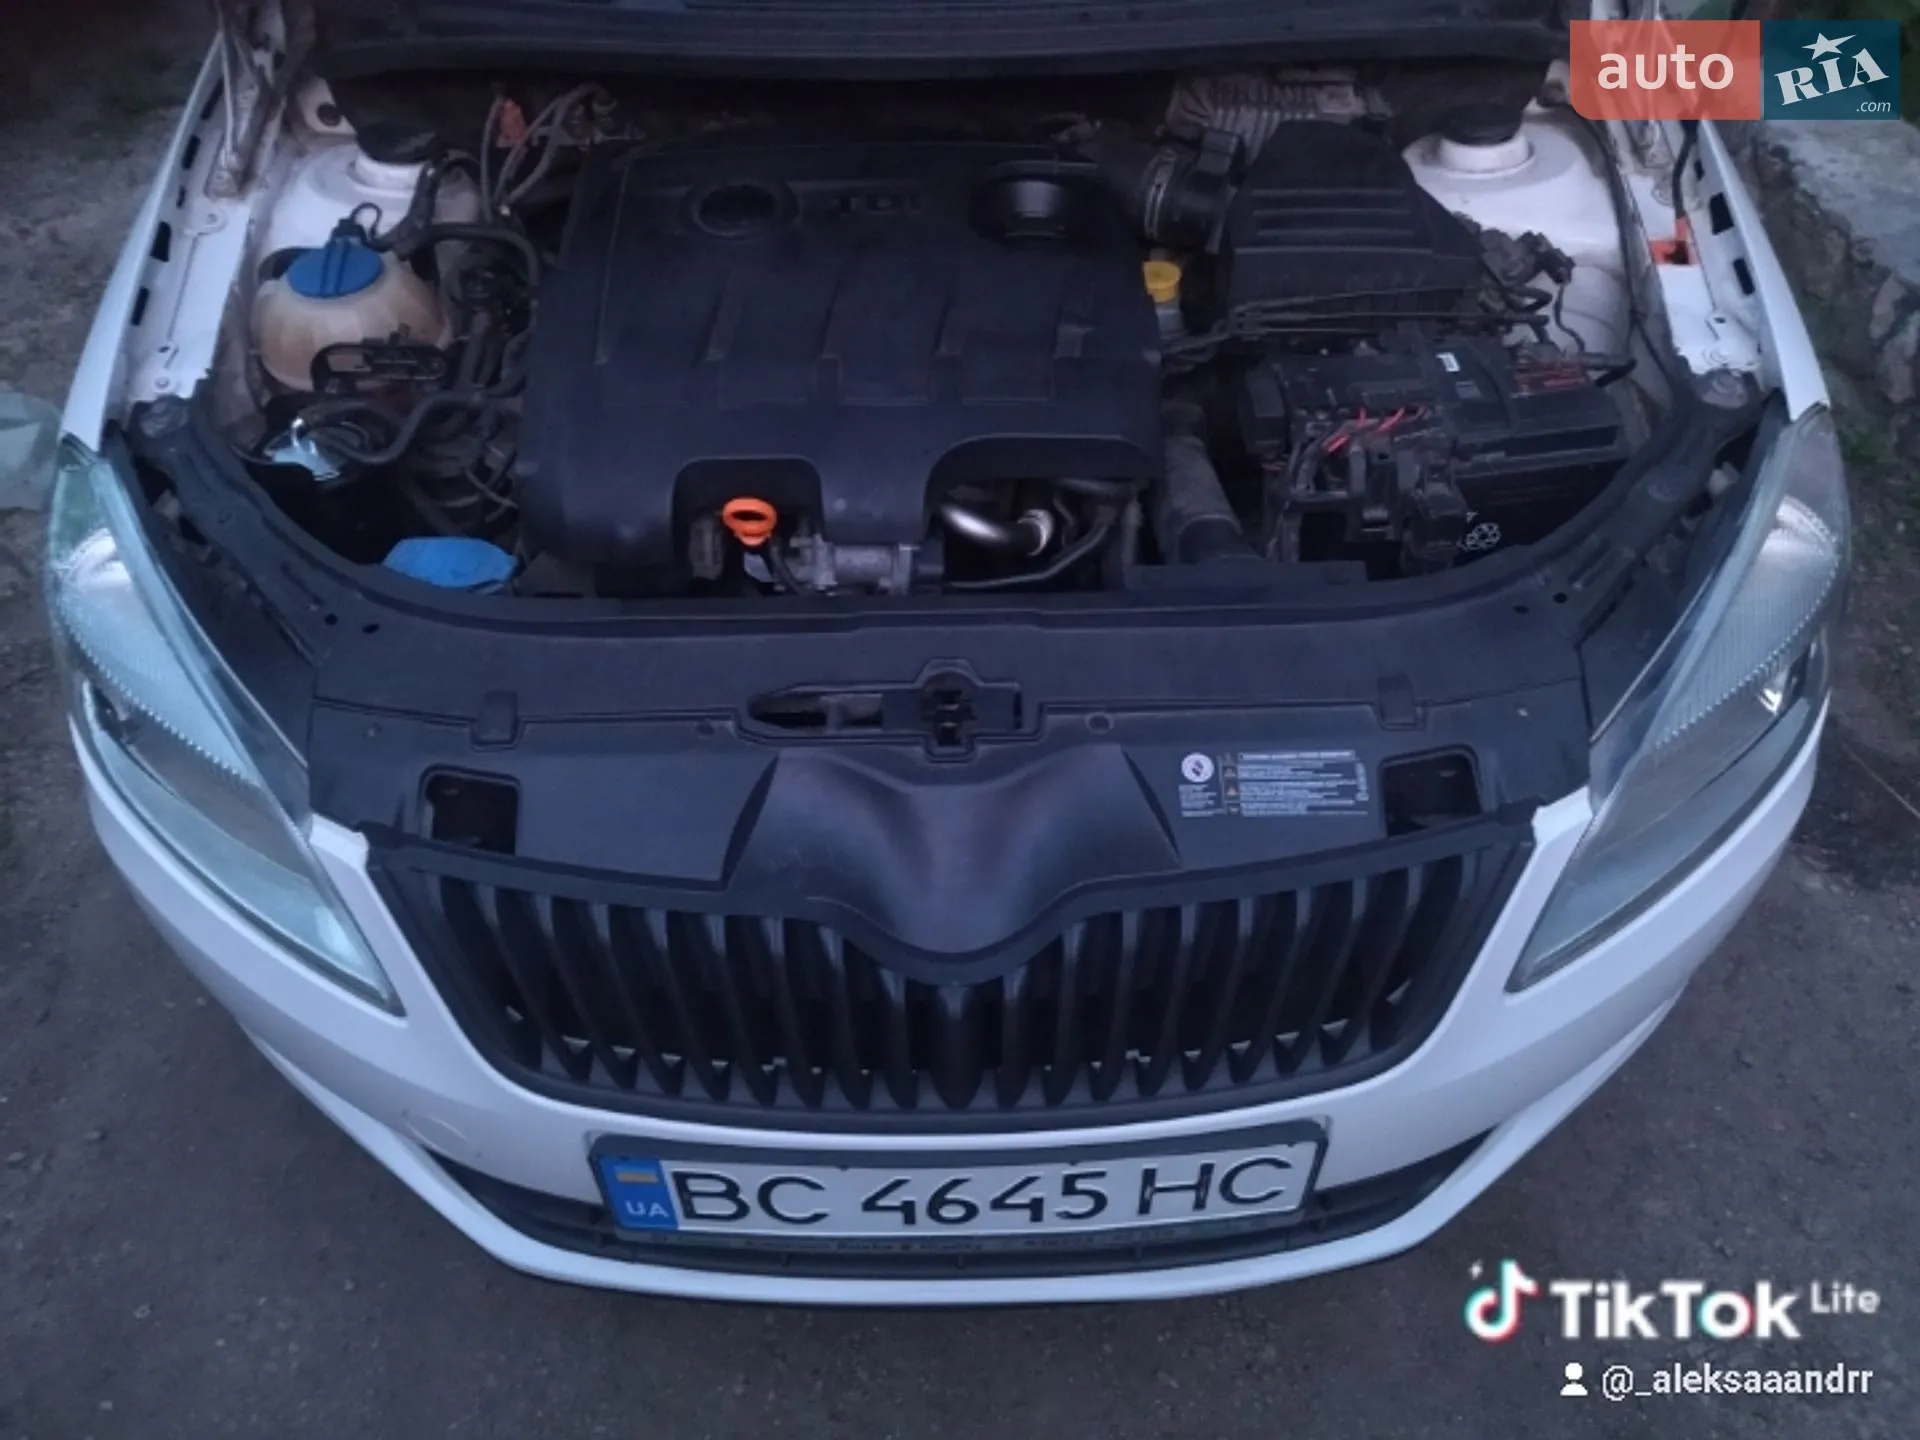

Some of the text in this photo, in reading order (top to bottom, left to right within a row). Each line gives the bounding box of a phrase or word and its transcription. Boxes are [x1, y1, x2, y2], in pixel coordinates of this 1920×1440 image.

[625, 1200, 669, 1218] UA
[671, 1156, 1293, 1226] BC 4645 HC
